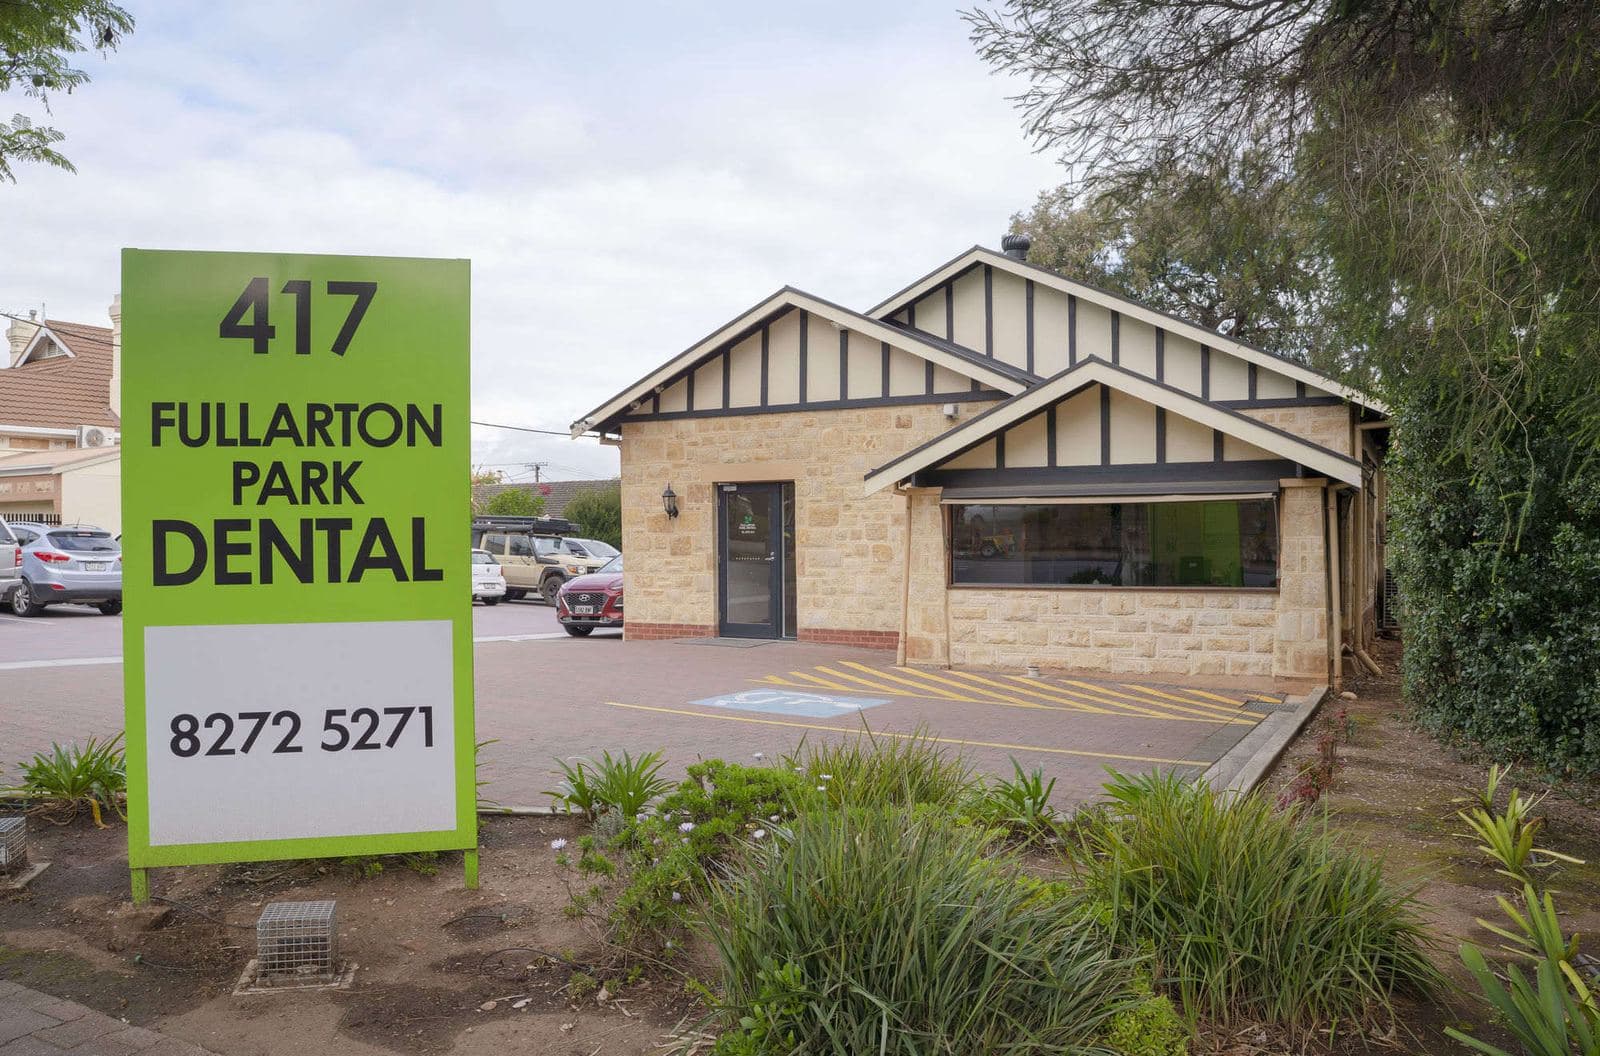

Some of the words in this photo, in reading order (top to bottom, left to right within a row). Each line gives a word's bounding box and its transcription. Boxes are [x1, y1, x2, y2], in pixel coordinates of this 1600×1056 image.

[219, 278, 378, 357] 417
[151, 402, 443, 449] FULLARTON
[232, 461, 365, 506] PARK
[152, 517, 444, 587] DENTAL
[170, 711, 303, 758] 8272
[321, 706, 433, 752] 5271
